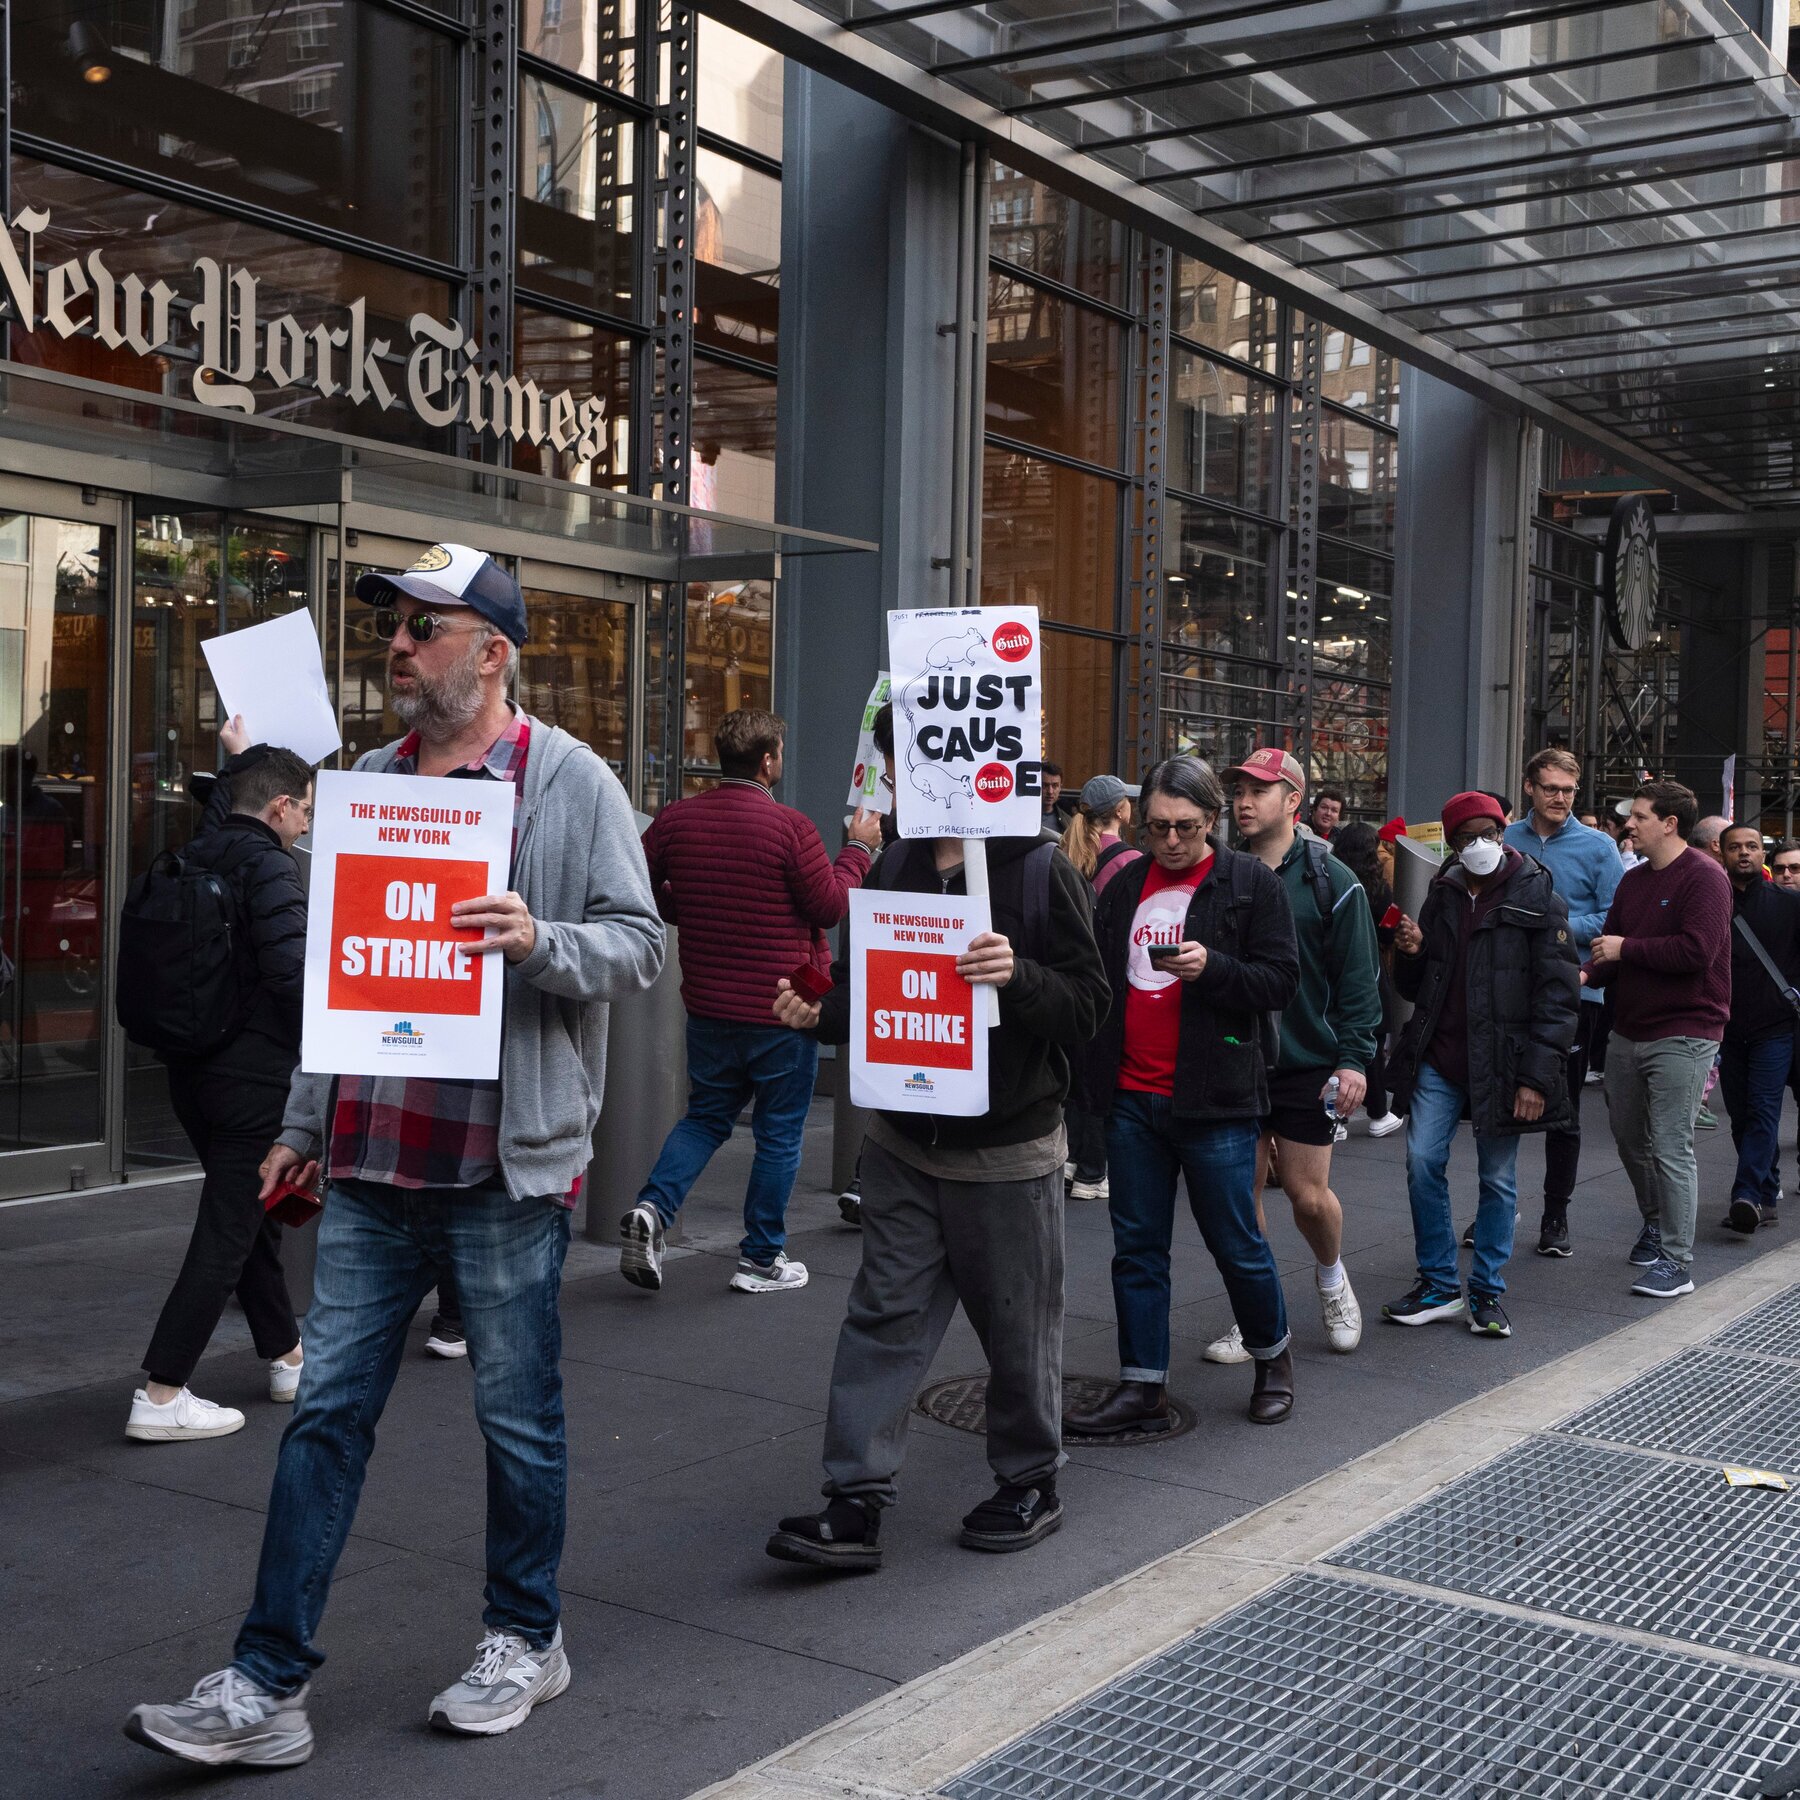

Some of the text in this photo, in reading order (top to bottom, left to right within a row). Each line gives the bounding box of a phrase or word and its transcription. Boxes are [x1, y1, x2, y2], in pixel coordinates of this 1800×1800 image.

[0, 205, 608, 463] New York Times
[995, 634, 1030, 651] Guild
[917, 674, 1033, 712] JUST
[977, 775, 1010, 791] Guild
[350, 803, 482, 825] THE NEWSGUILD OF
[378, 827, 451, 845] NEW YORK
[904, 825, 932, 835] JUST
[385, 880, 437, 922] ON
[873, 912, 965, 930] THE NEWSGUILD OF
[894, 930, 944, 944] NEW YORK
[1133, 923, 1185, 947] Guil
[341, 935, 472, 981] STRIKE
[901, 969, 937, 1000] ON
[873, 1009, 965, 1044] STRIKE
[381, 1036, 423, 1045] NEWSGUILD
[904, 1082, 934, 1091] NEWSGUILD
